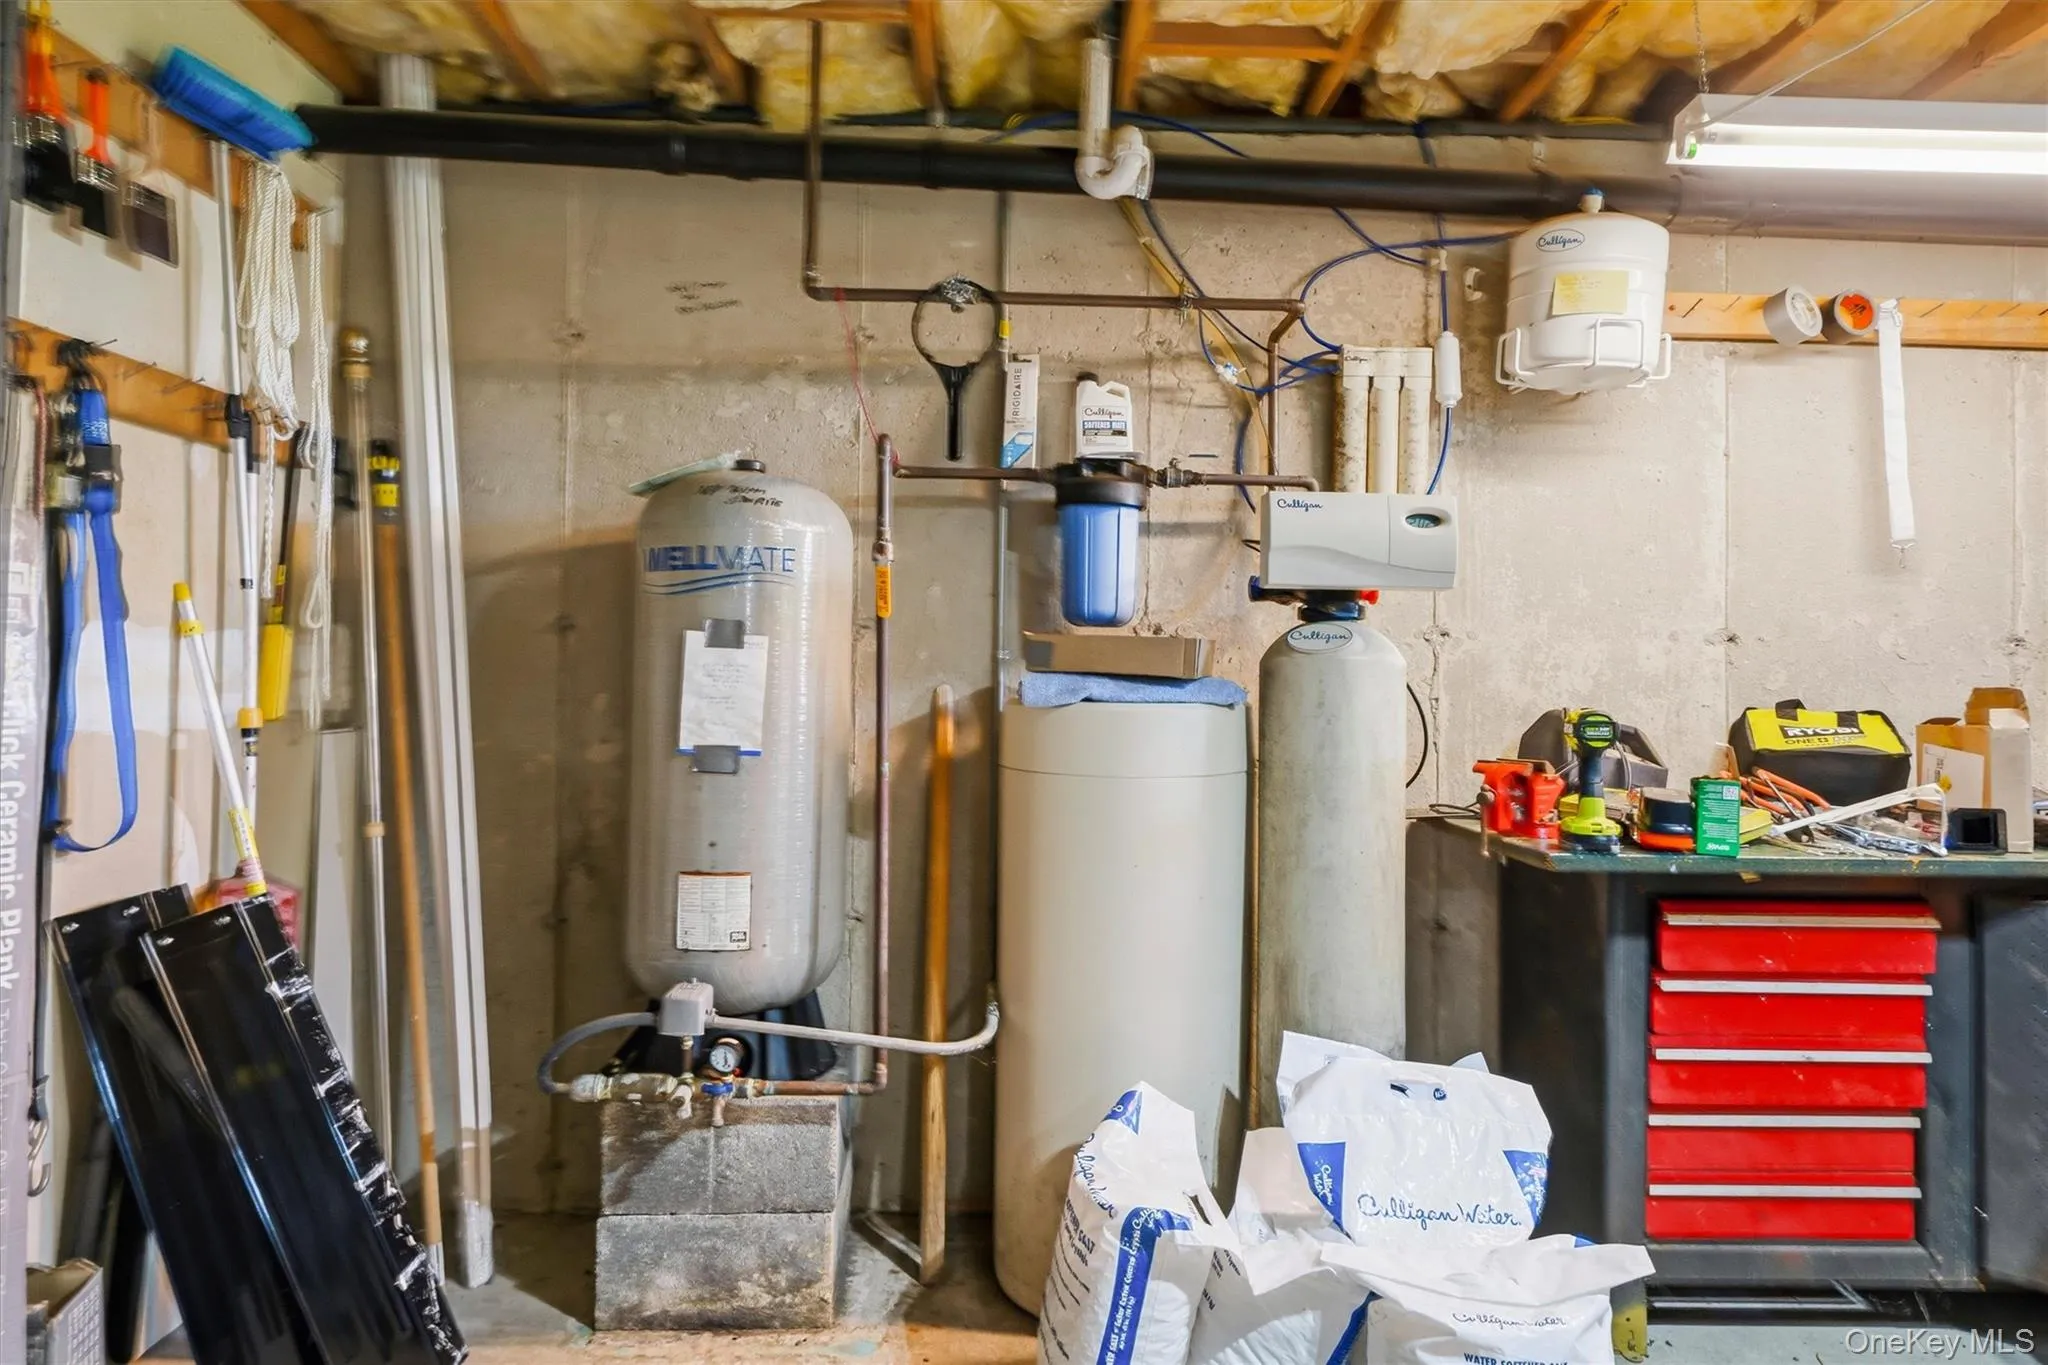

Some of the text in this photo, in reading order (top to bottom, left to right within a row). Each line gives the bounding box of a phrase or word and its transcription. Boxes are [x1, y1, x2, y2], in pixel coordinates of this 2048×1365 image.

[1538, 234, 1582, 249] Culligan
[1012, 367, 1023, 421] RIGIDAIRE
[1276, 498, 1323, 514] Culligan
[1289, 629, 1350, 645] Culligan
[1784, 727, 1860, 737] RYOBI
[1, 781, 28, 901] Ceramic
[1, 908, 23, 990] Plank
[1357, 1193, 1459, 1230] Culligan
[1464, 1352, 1497, 1365] WATER
